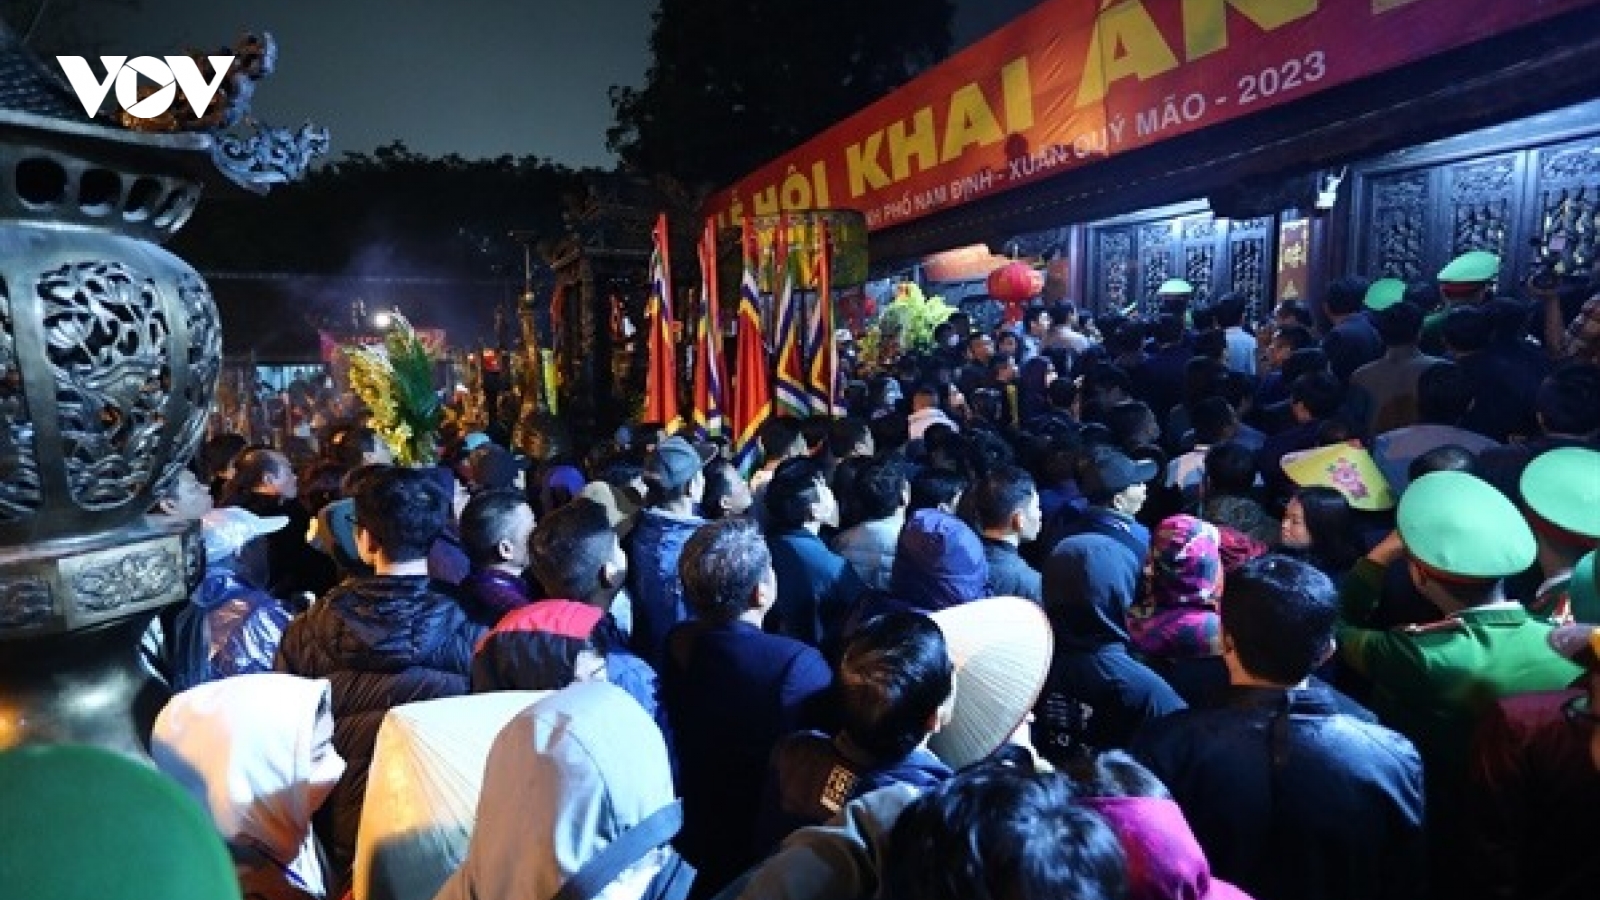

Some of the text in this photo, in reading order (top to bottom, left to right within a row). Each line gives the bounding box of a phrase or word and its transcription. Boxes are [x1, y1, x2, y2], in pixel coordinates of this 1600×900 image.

[846, 56, 1034, 198] KHAI
[913, 184, 946, 211] NAM
[1136, 94, 1206, 137] MÃO
[1238, 50, 1326, 105] 2023
